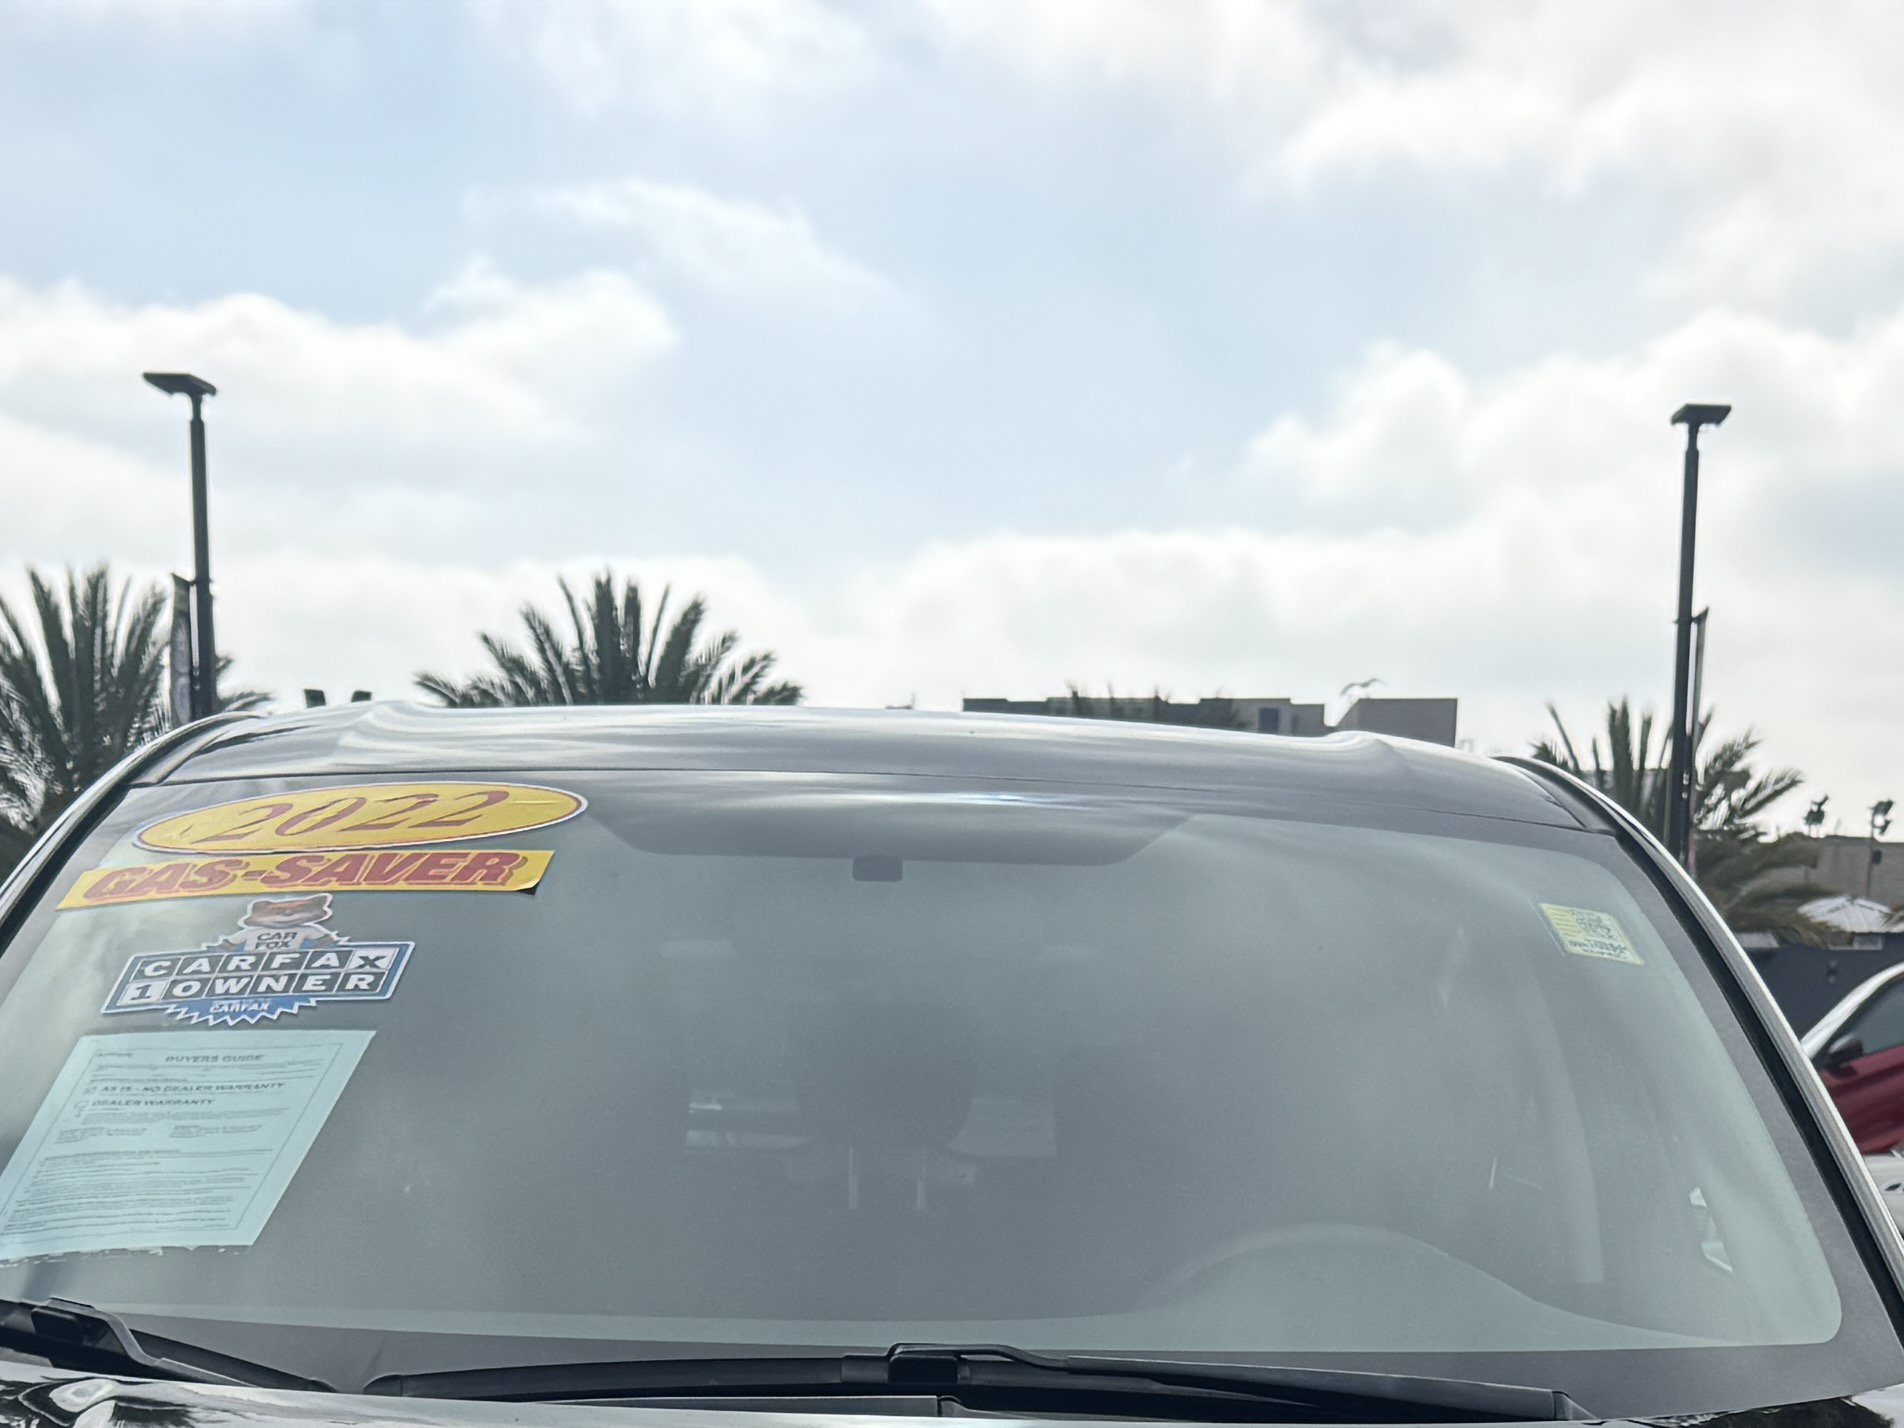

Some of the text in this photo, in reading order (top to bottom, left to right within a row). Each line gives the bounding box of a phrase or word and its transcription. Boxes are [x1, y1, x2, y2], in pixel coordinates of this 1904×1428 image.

[194, 791, 510, 843] 2022
[84, 851, 528, 900] GAS-SAVER
[255, 940, 291, 949] FOX
[257, 931, 298, 941] CAR
[141, 949, 392, 978] CARFAX
[171, 972, 374, 998] OWNER
